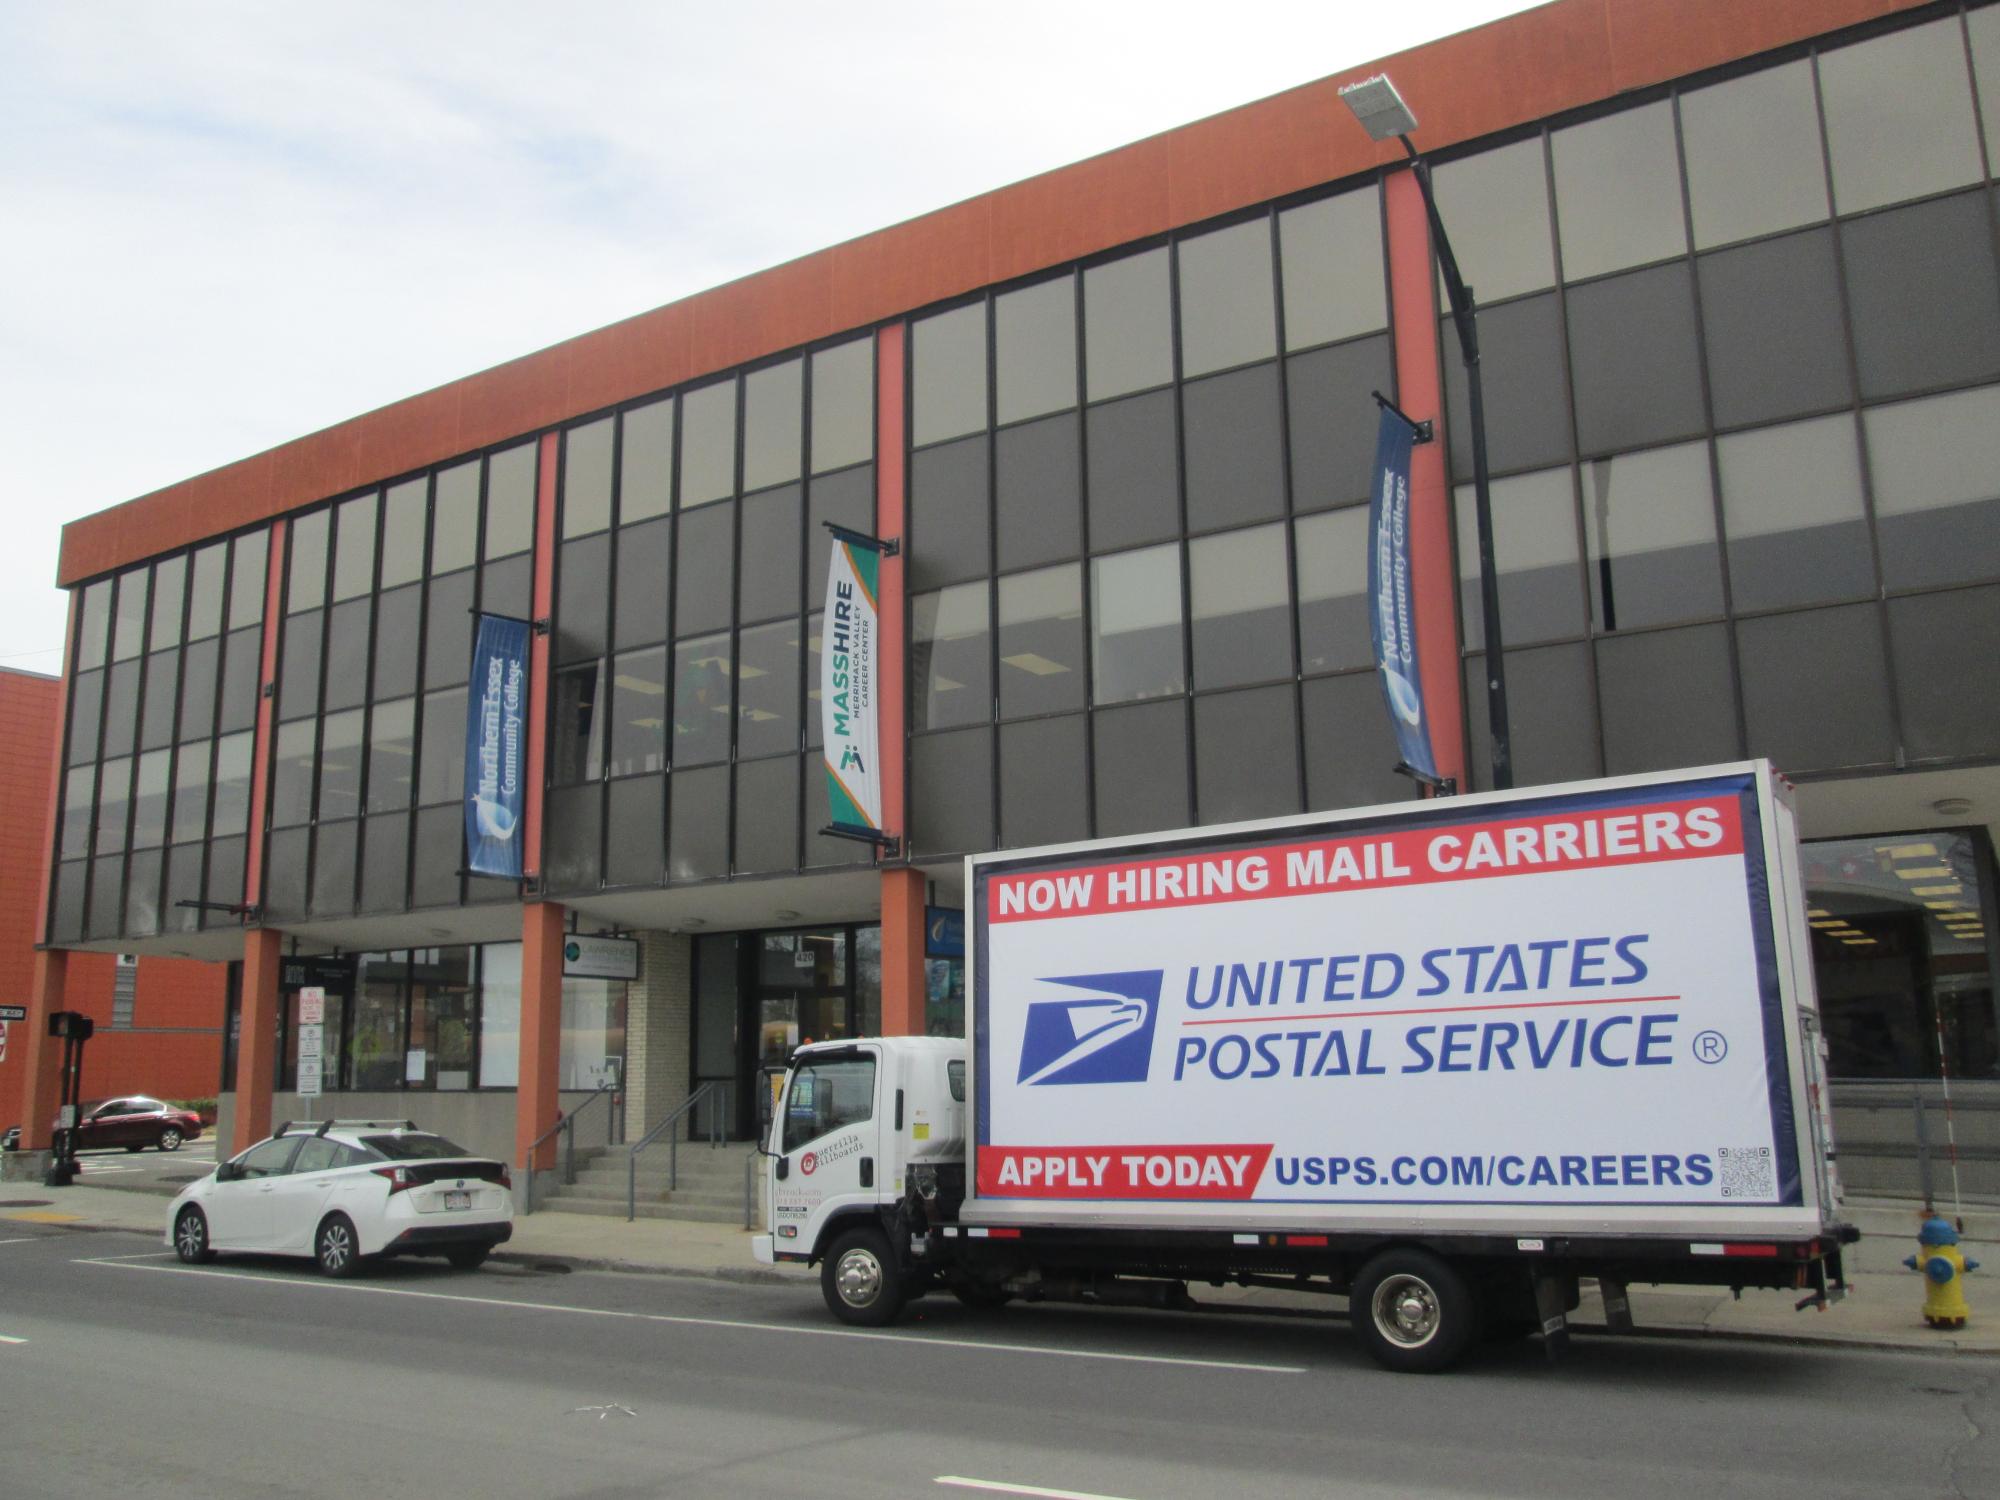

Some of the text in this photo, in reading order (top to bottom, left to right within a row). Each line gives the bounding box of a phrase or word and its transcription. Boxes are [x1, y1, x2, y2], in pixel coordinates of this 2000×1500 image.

[1377, 467, 1399, 660] Northern Essex
[1392, 475, 1412, 663] Community College
[832, 580, 853, 737] MASSHIRE
[852, 604, 861, 719] MERRIMACK VALLEY
[861, 618, 870, 708] CAREER CENTER
[479, 655, 503, 794] Northern Essex
[501, 659, 523, 795] Community College
[999, 807, 1724, 915] NOW HIRING MAIL CARRIERS
[1185, 934, 1649, 1010] UNITED STATES
[1173, 1027, 1387, 1082] POSTAL
[1401, 1013, 1680, 1075] SERVICE
[814, 1134, 859, 1161] guerrilla
[998, 1153, 1715, 1188] APPLY TODAY USPS.COM/CAREERS
